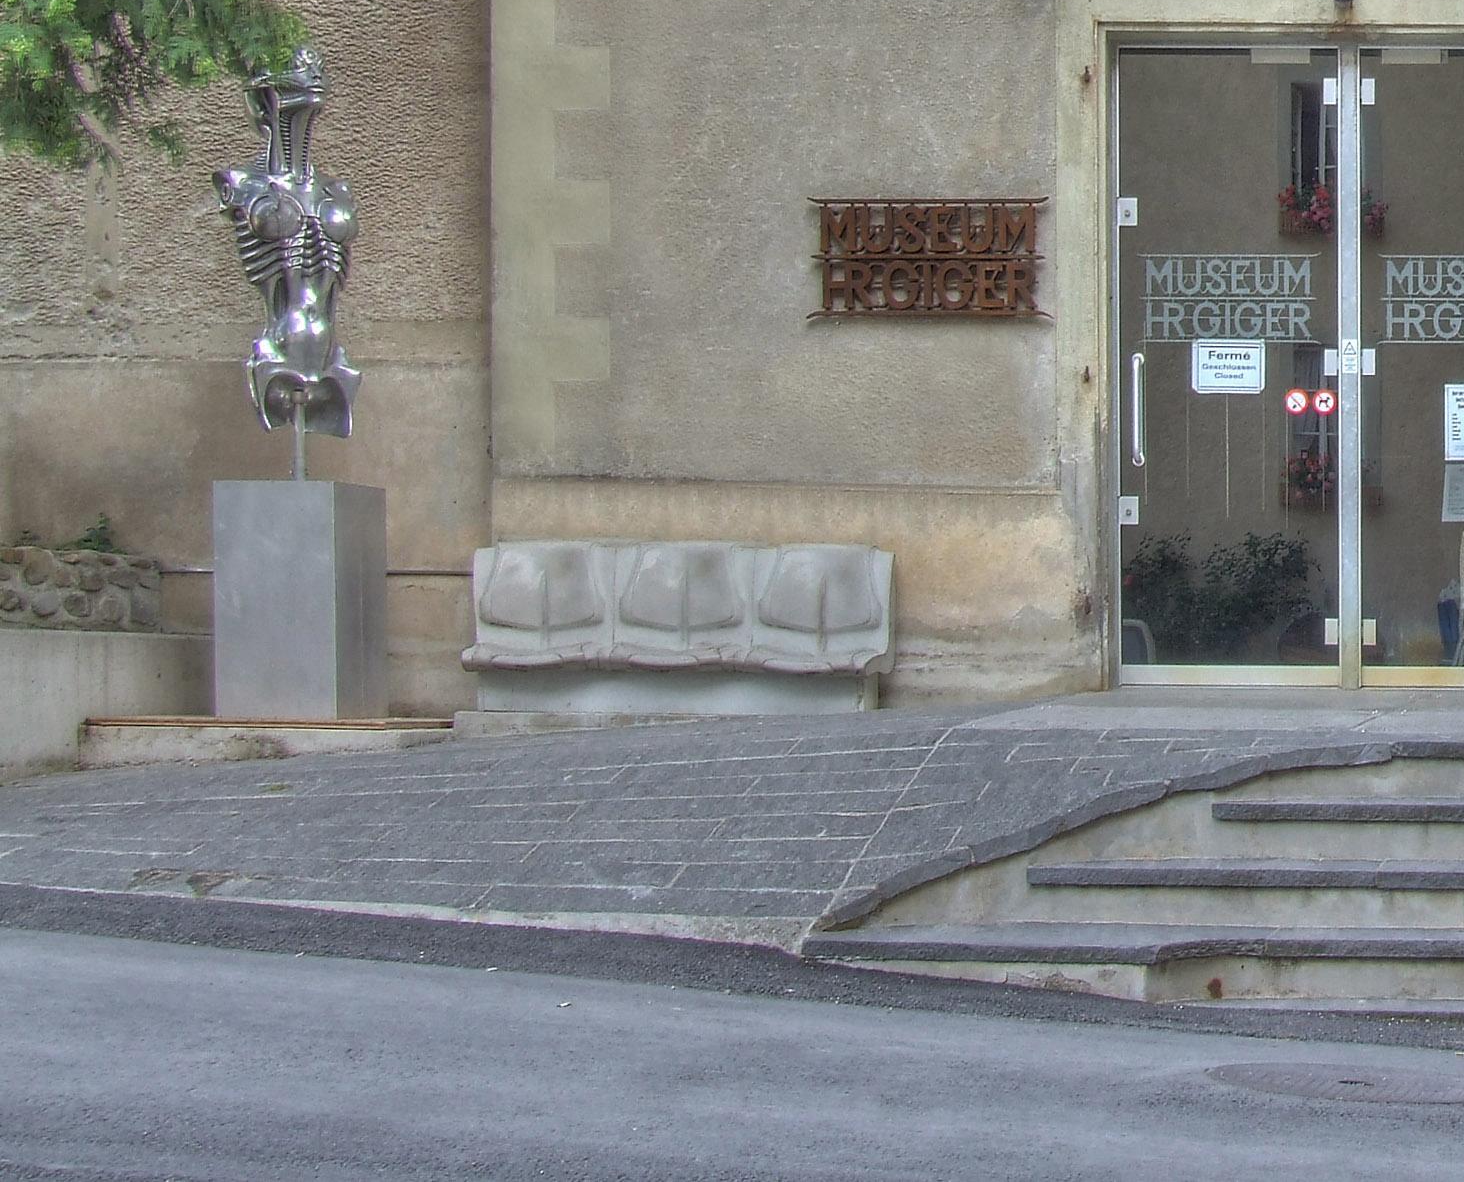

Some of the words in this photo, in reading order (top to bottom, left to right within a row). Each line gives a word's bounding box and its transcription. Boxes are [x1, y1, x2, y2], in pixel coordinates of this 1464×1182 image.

[819, 206, 1036, 253] MUSEUM
[822, 260, 874, 309] HR
[882, 259, 1039, 310] GIGER
[1146, 259, 1311, 295] MUSEUM
[1146, 302, 1186, 338] HR
[1193, 300, 1312, 338] GIGER
[1386, 303, 1427, 339] HR
[1202, 363, 1257, 371] Geschlossen
[1208, 350, 1251, 361] Fermé
